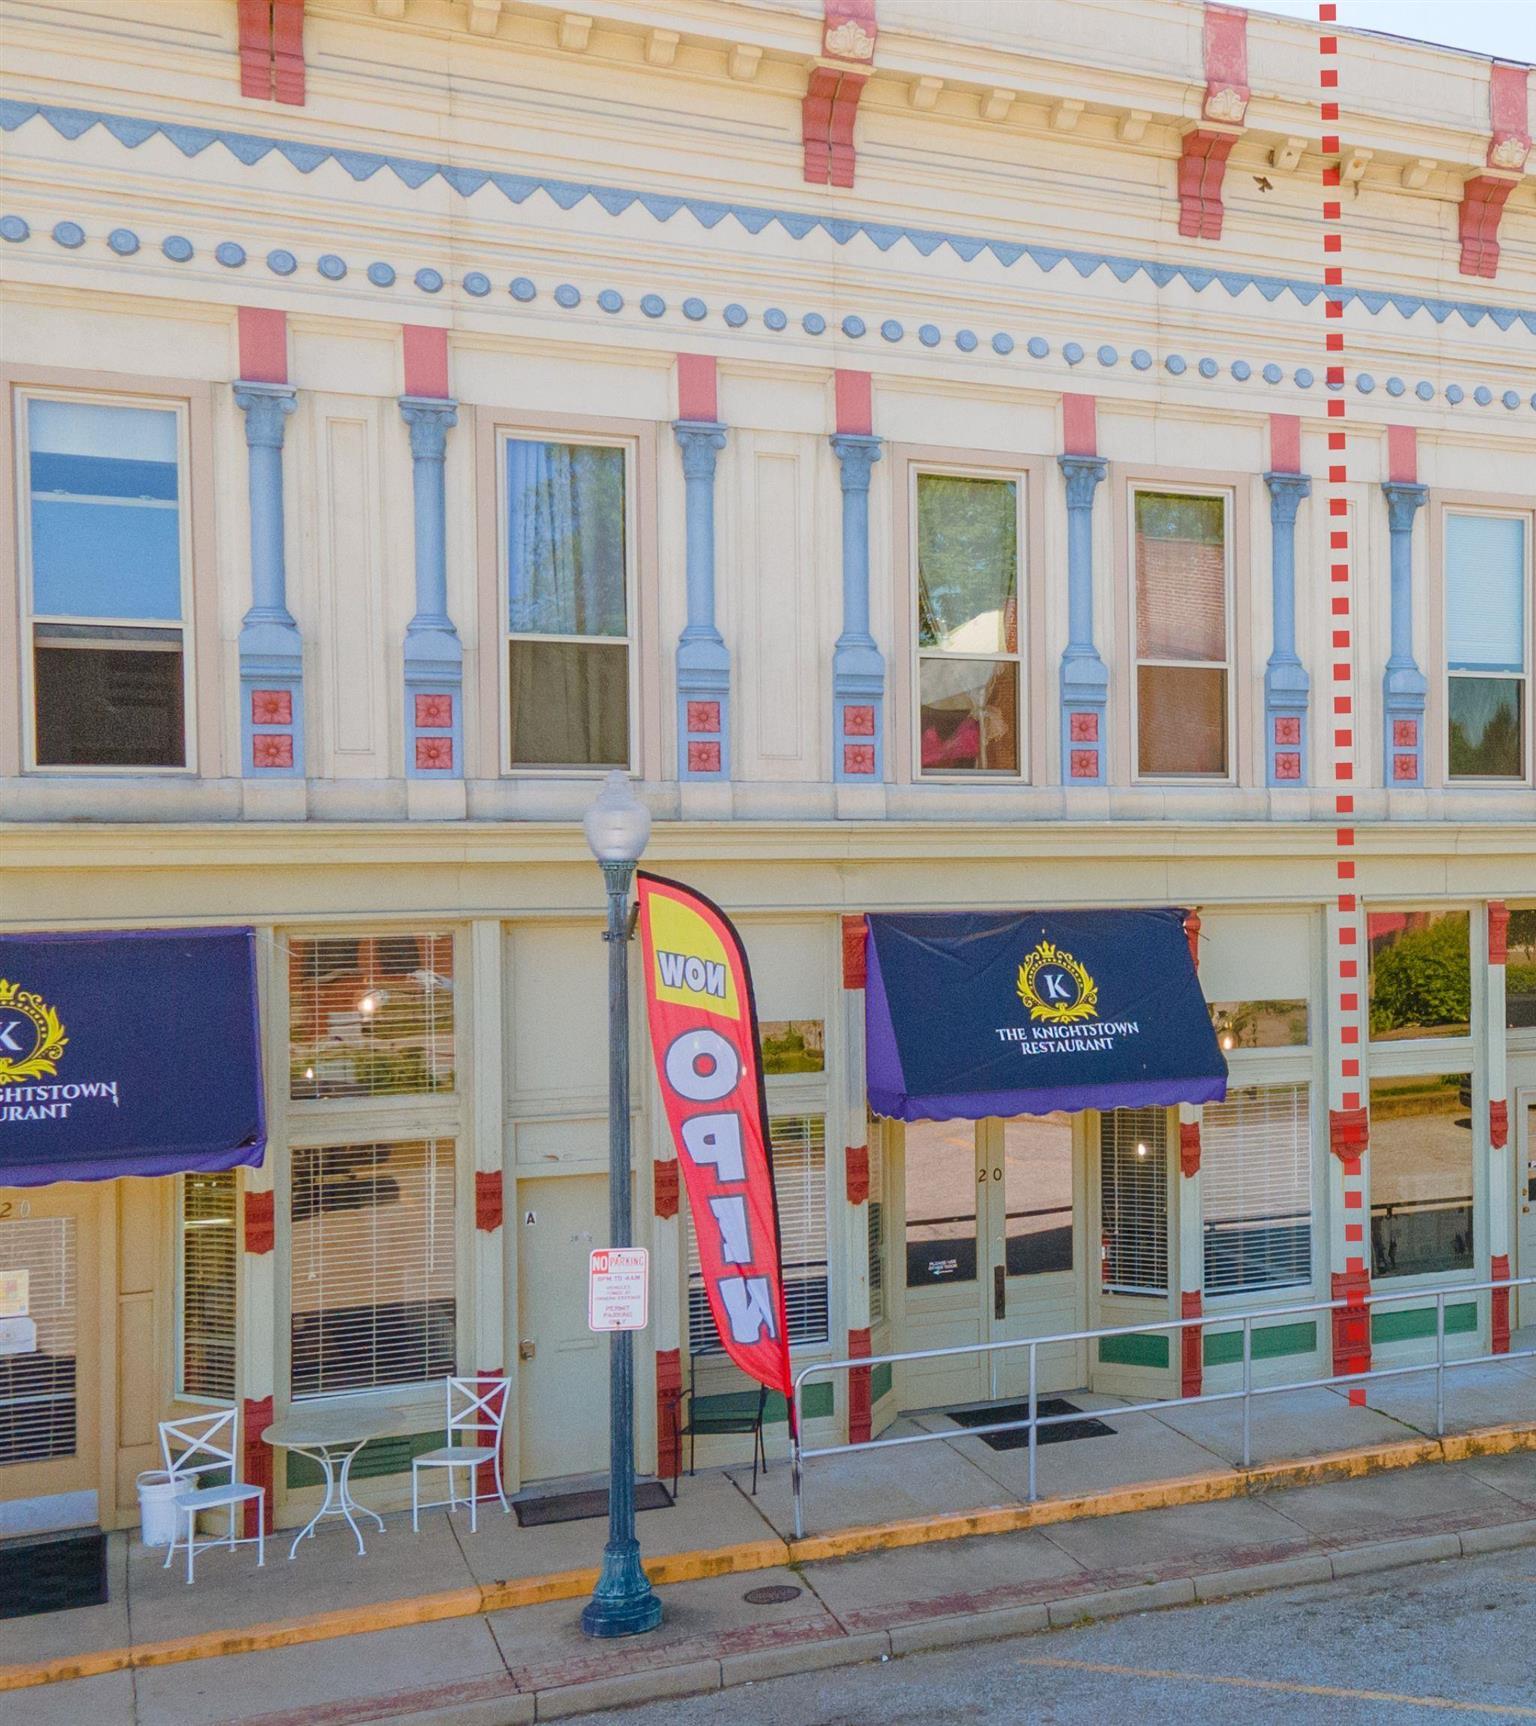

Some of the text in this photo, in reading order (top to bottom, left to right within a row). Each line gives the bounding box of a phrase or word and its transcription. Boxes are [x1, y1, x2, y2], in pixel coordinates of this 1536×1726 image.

[1043, 974, 1071, 999] K
[995, 1022, 1140, 1041] THE KNIGHTSTOWN
[1021, 1038, 1114, 1055] RESTAURANT
[526, 1212, 535, 1224] A
[592, 1256, 644, 1271] NO PARKING
